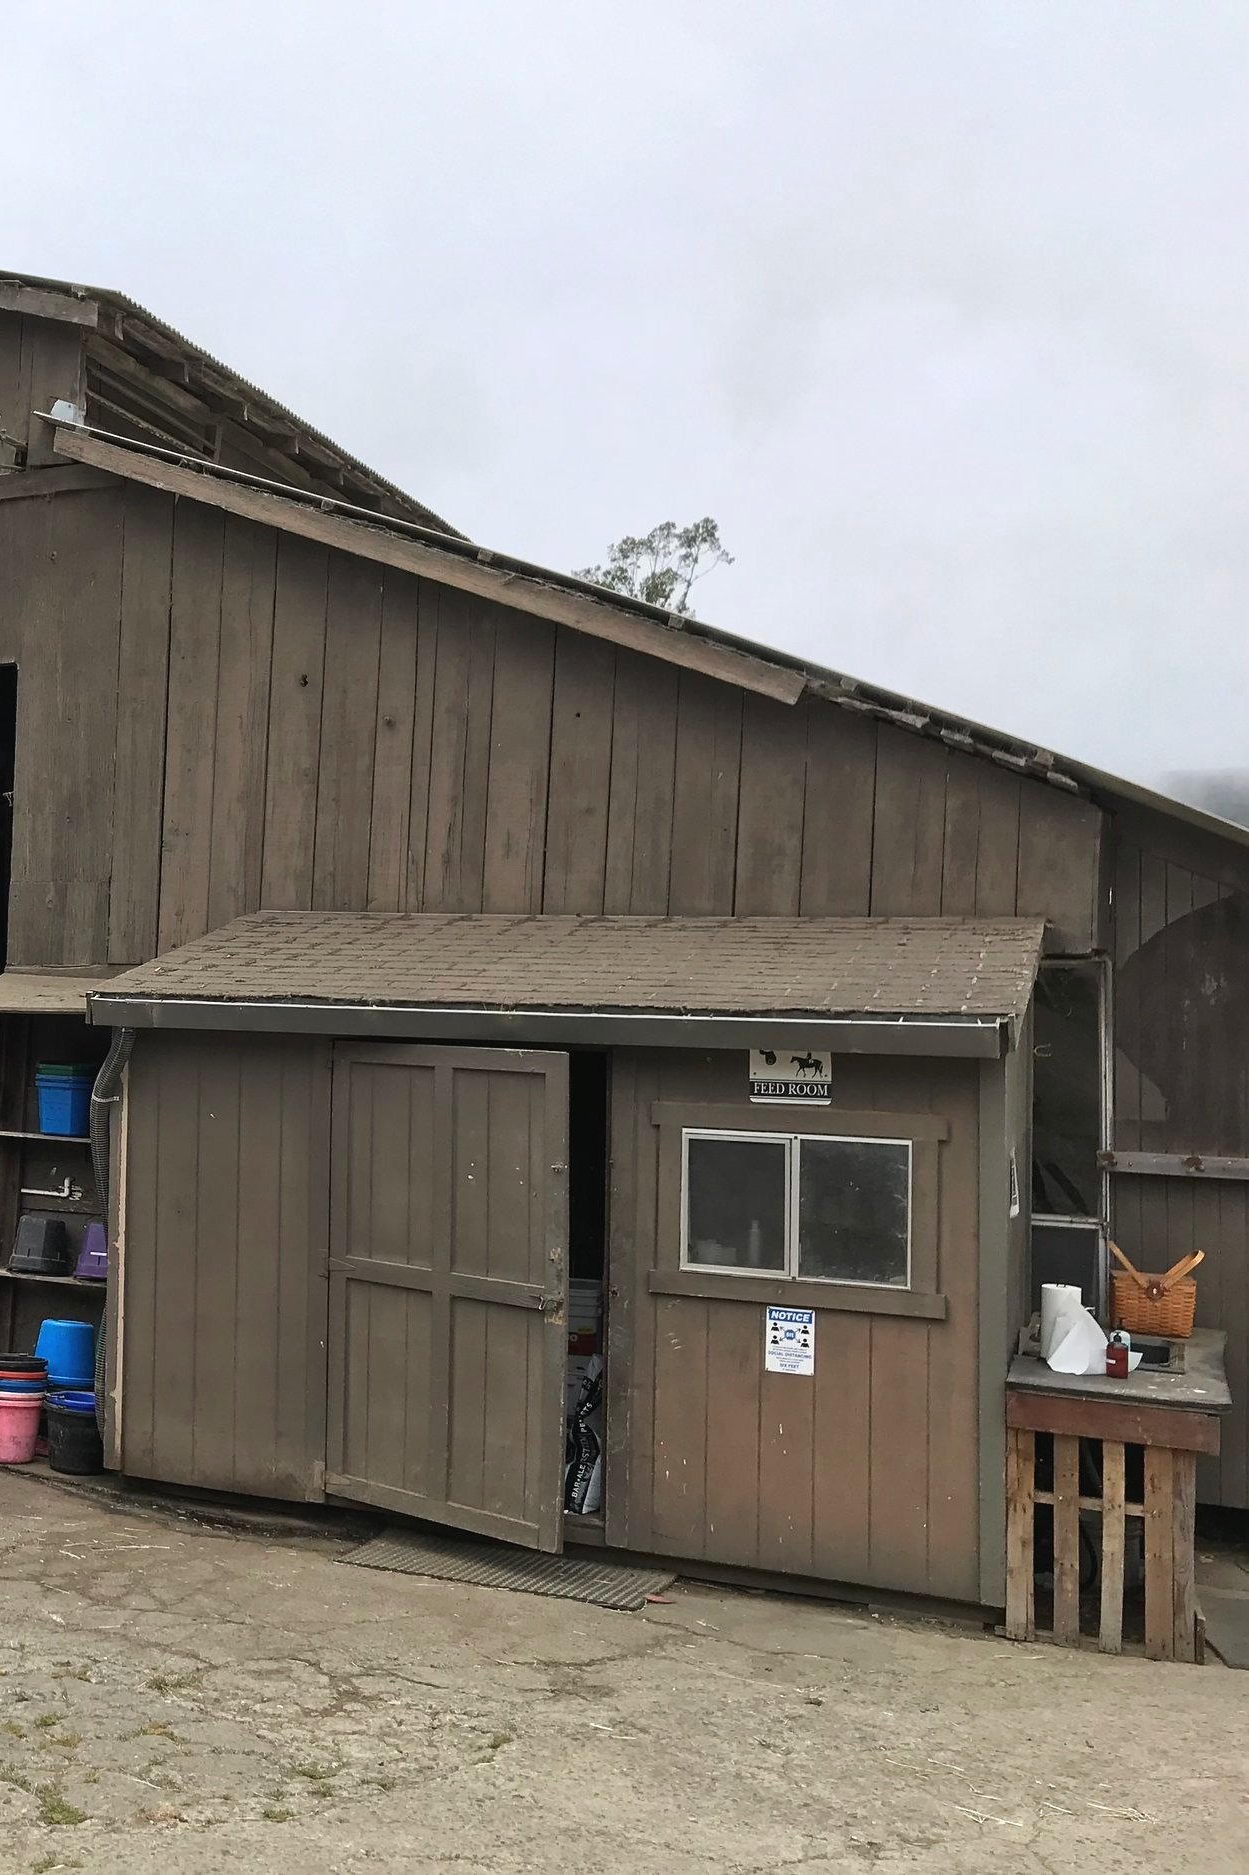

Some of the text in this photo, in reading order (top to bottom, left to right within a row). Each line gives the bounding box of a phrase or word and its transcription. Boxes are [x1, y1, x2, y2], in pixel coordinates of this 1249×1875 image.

[754, 1082, 829, 1096] FEED ROOM
[771, 1310, 810, 1322] NOTICE
